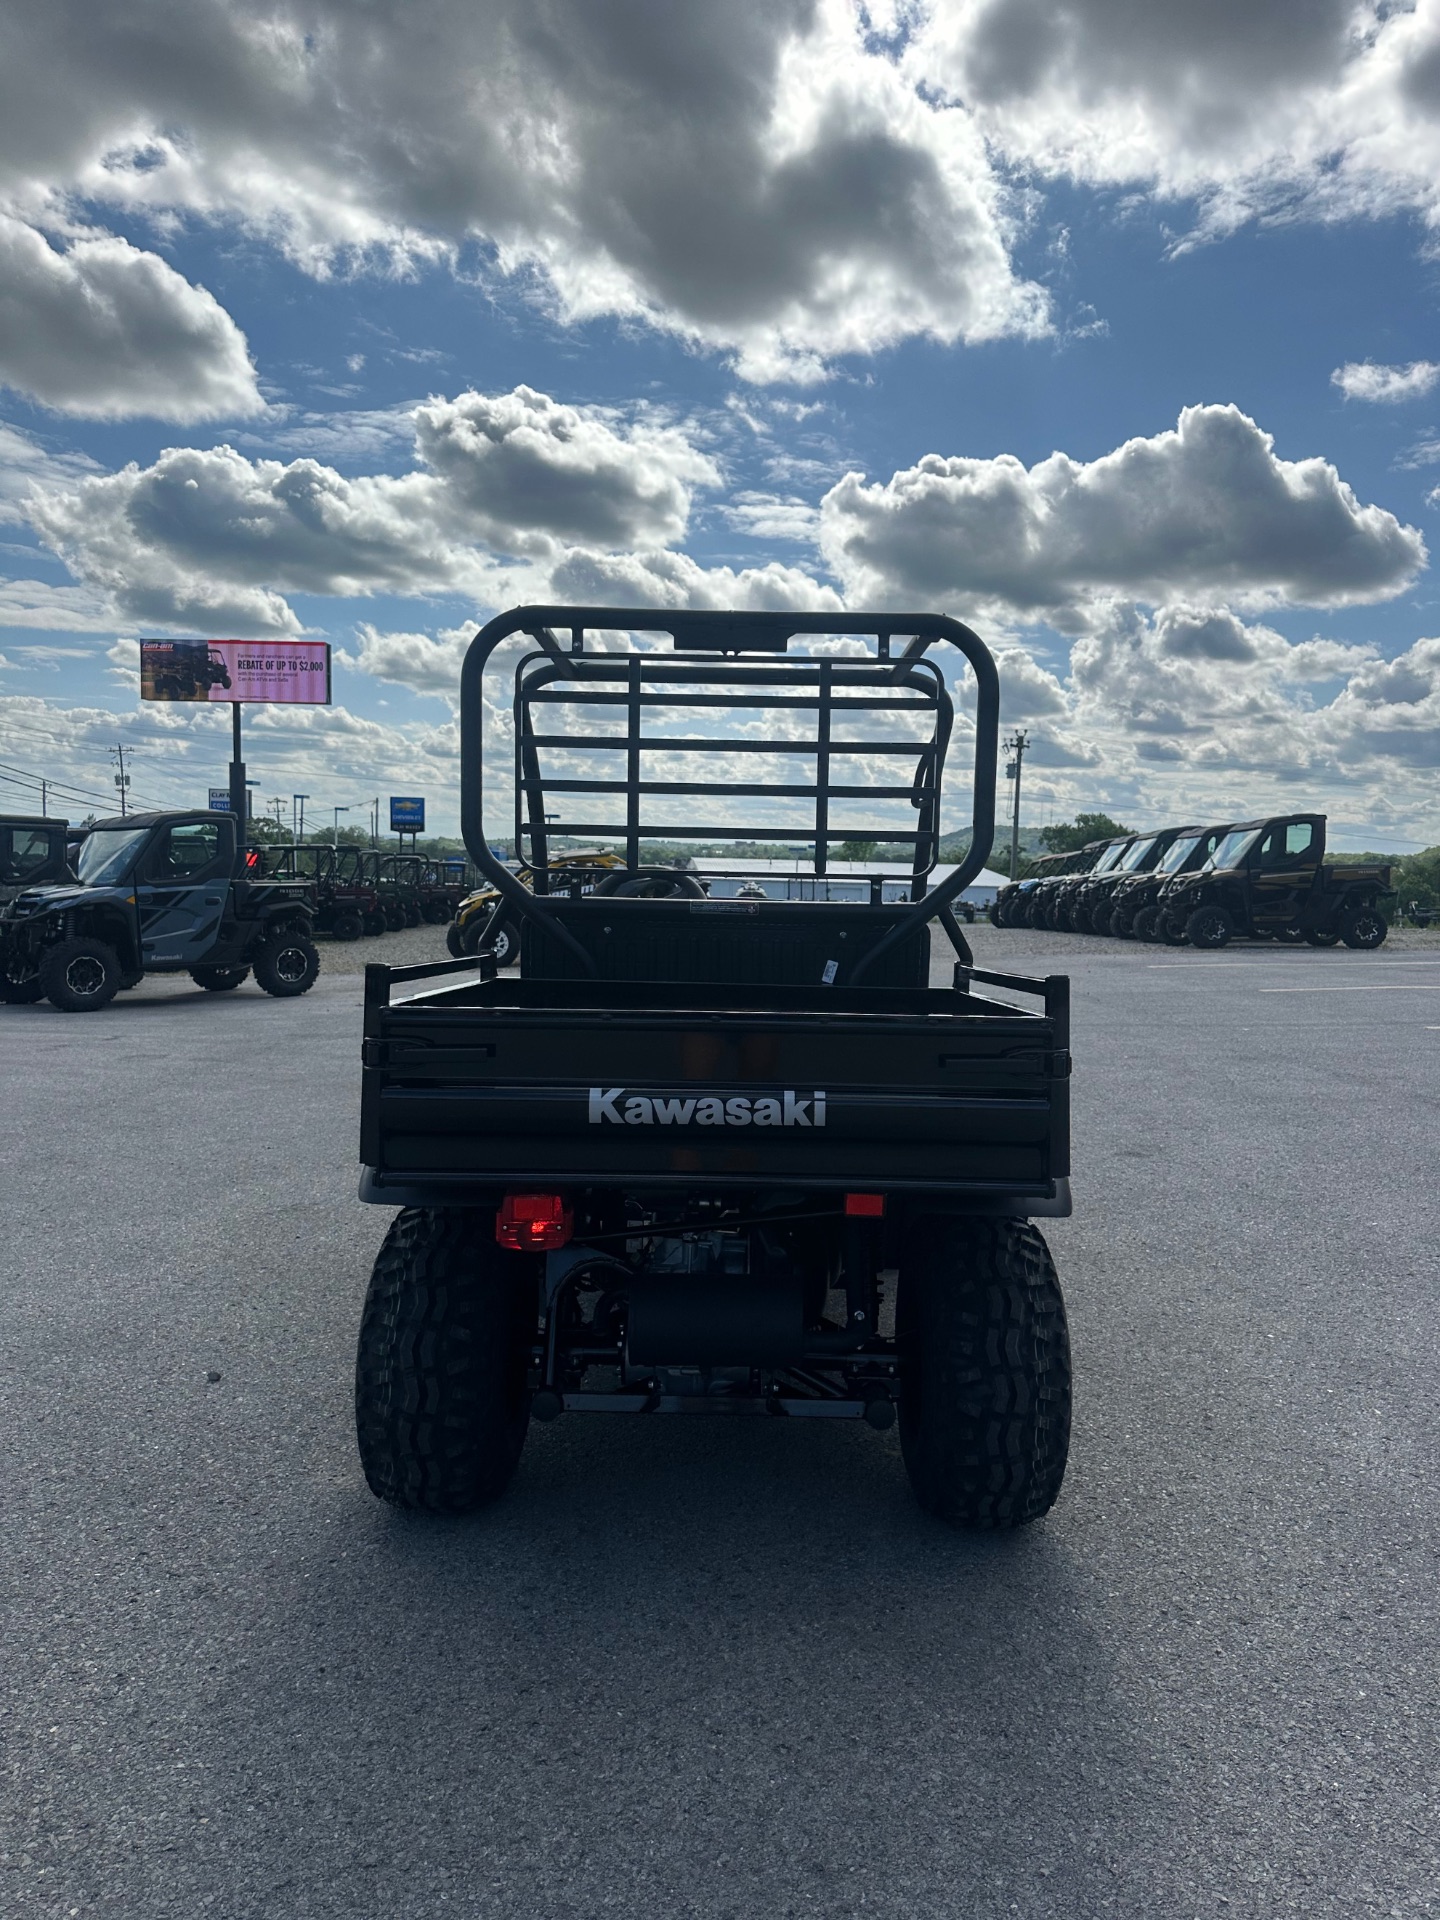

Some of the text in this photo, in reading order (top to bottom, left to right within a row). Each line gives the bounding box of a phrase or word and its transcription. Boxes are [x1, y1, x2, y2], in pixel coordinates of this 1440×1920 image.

[238, 660, 324, 672] REBATE OF UP TO $2,000
[589, 1088, 826, 1126] Kawasaki
